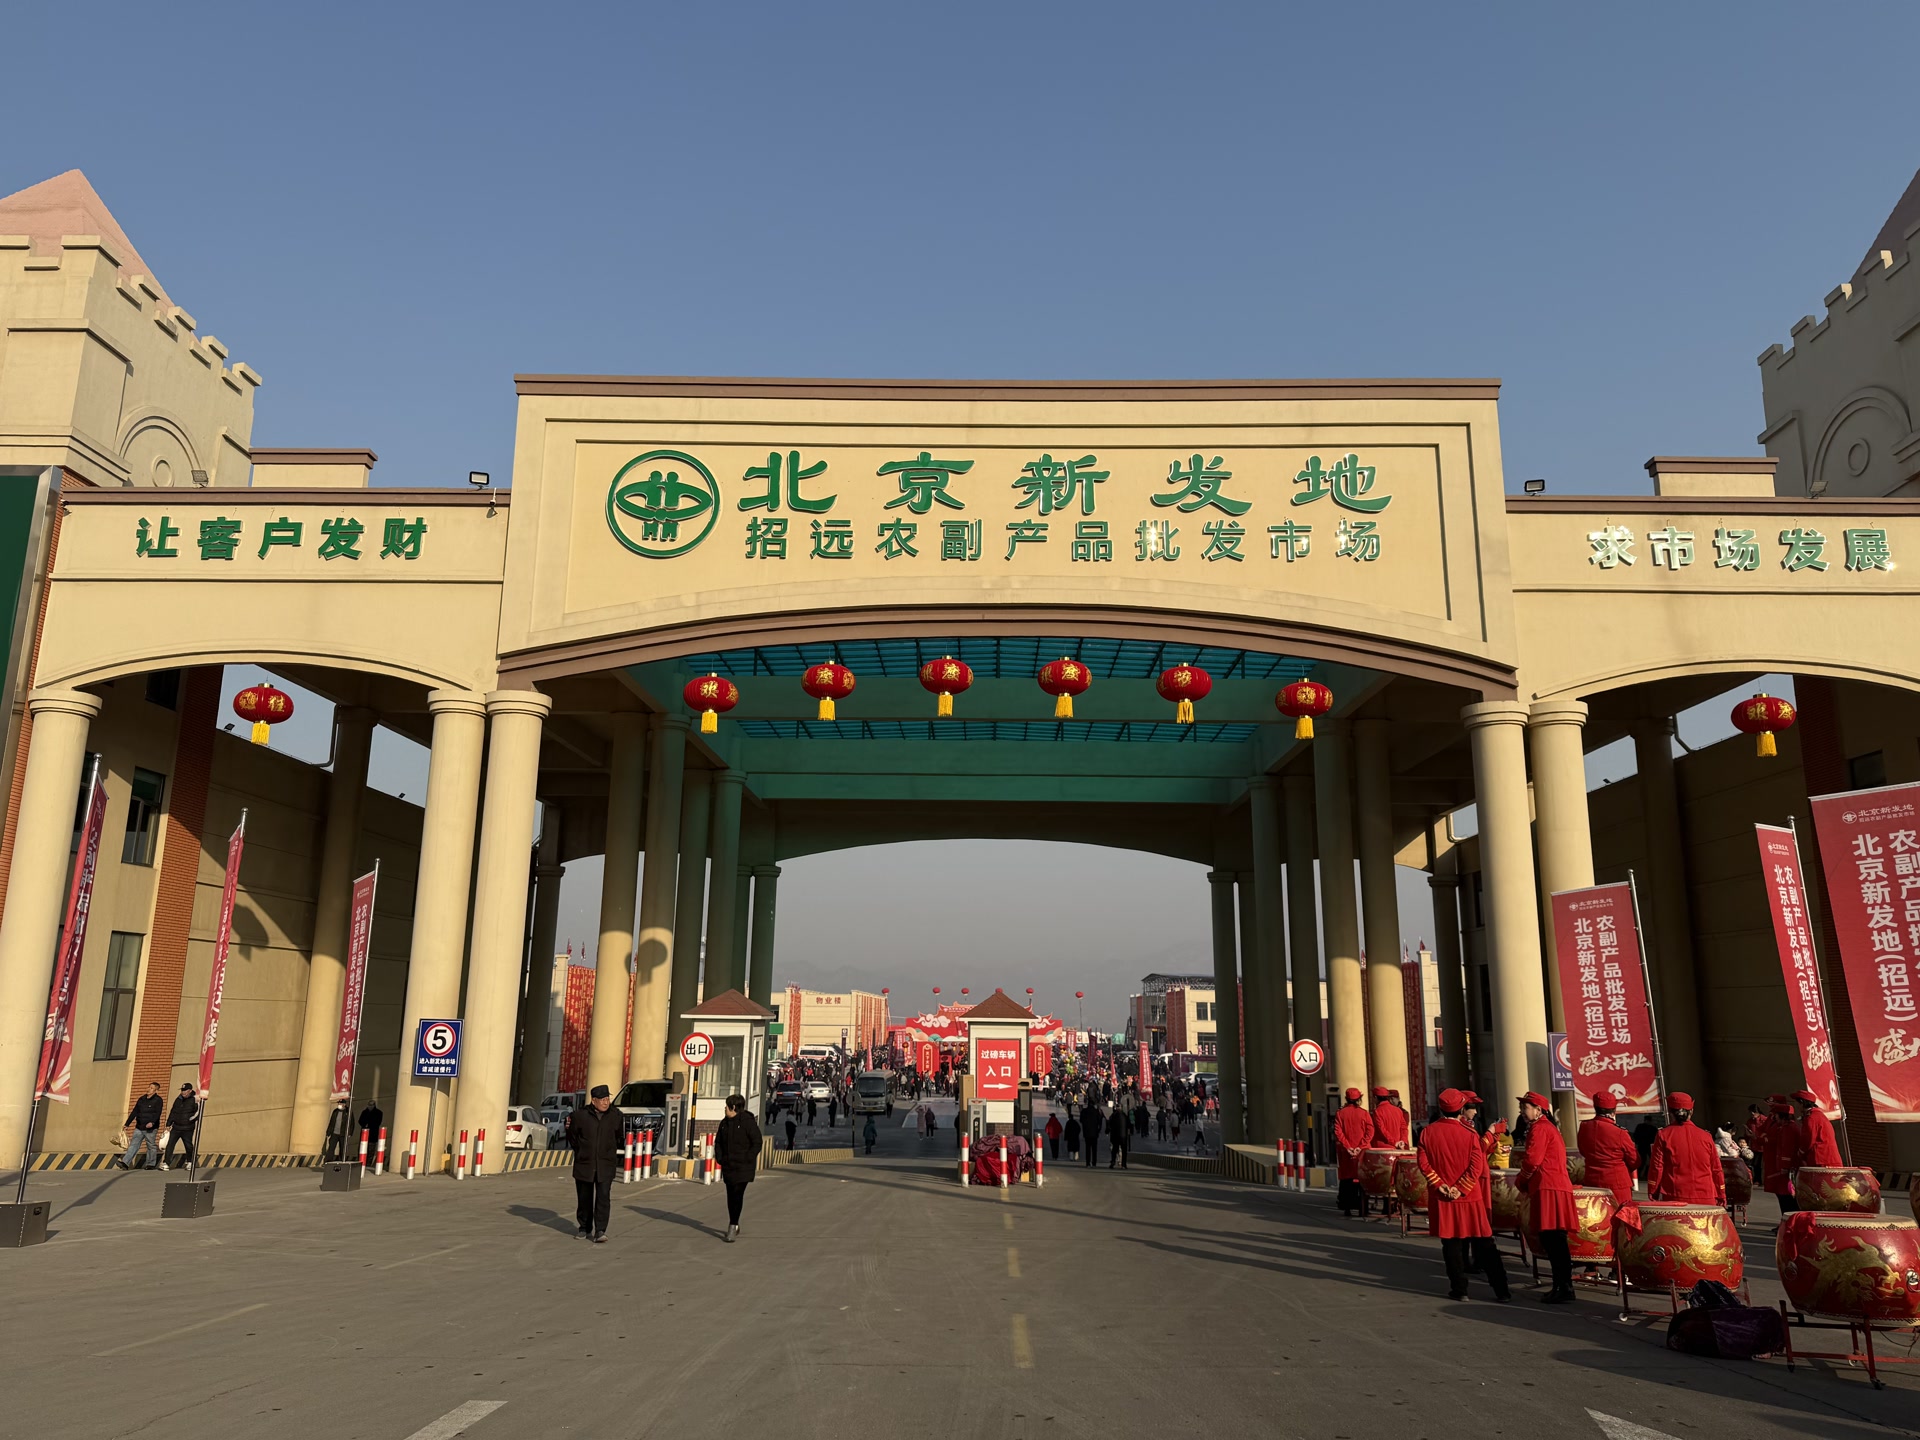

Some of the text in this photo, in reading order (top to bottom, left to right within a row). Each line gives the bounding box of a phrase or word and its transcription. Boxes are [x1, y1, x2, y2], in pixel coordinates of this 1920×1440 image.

[738, 450, 1394, 515] 北京新发地
[135, 515, 428, 561] 让客户发财
[745, 517, 1384, 562] 招远农副产品批发市场
[1587, 525, 1894, 572] 求市场发展
[1774, 864, 1819, 1032] 北京新发地(招远)
[1851, 834, 1919, 1022] 北京新发地(招远)
[1574, 918, 1609, 1047] 北京新发地(招远)
[1596, 915, 1632, 1045] 农副产品批发市场
[432, 1029, 447, 1050] 5
[686, 1043, 708, 1056] 出口
[981, 1050, 1016, 1060] 过磅车辆
[1297, 1050, 1318, 1063] 入口
[986, 1065, 1012, 1077] 入口
[1578, 1050, 1653, 1077] 盛大开业
